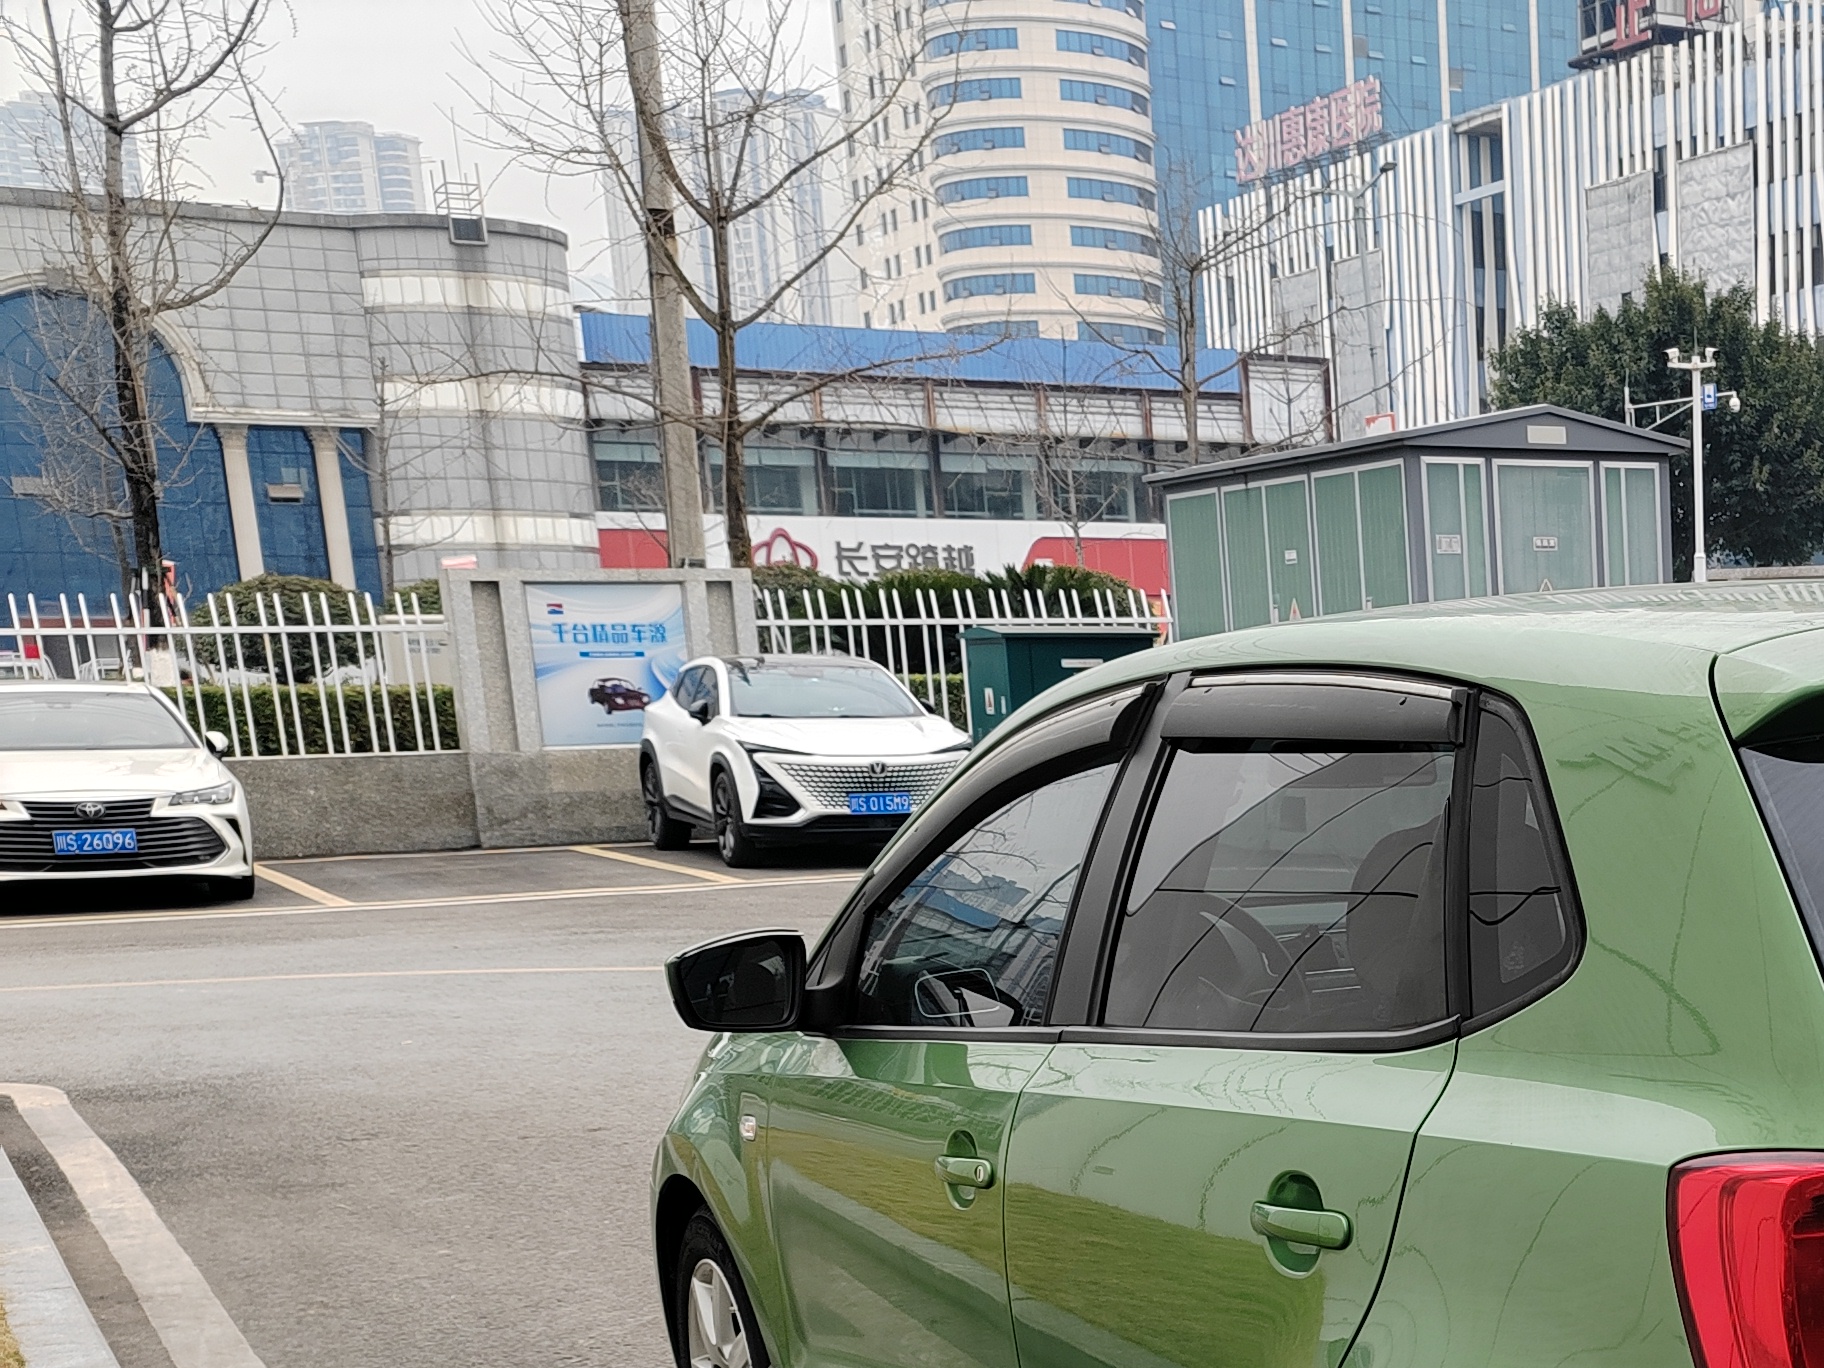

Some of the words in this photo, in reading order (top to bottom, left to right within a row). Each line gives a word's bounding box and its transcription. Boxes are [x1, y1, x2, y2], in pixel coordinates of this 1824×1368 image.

[1234, 75, 1383, 184] 达川惠康医院
